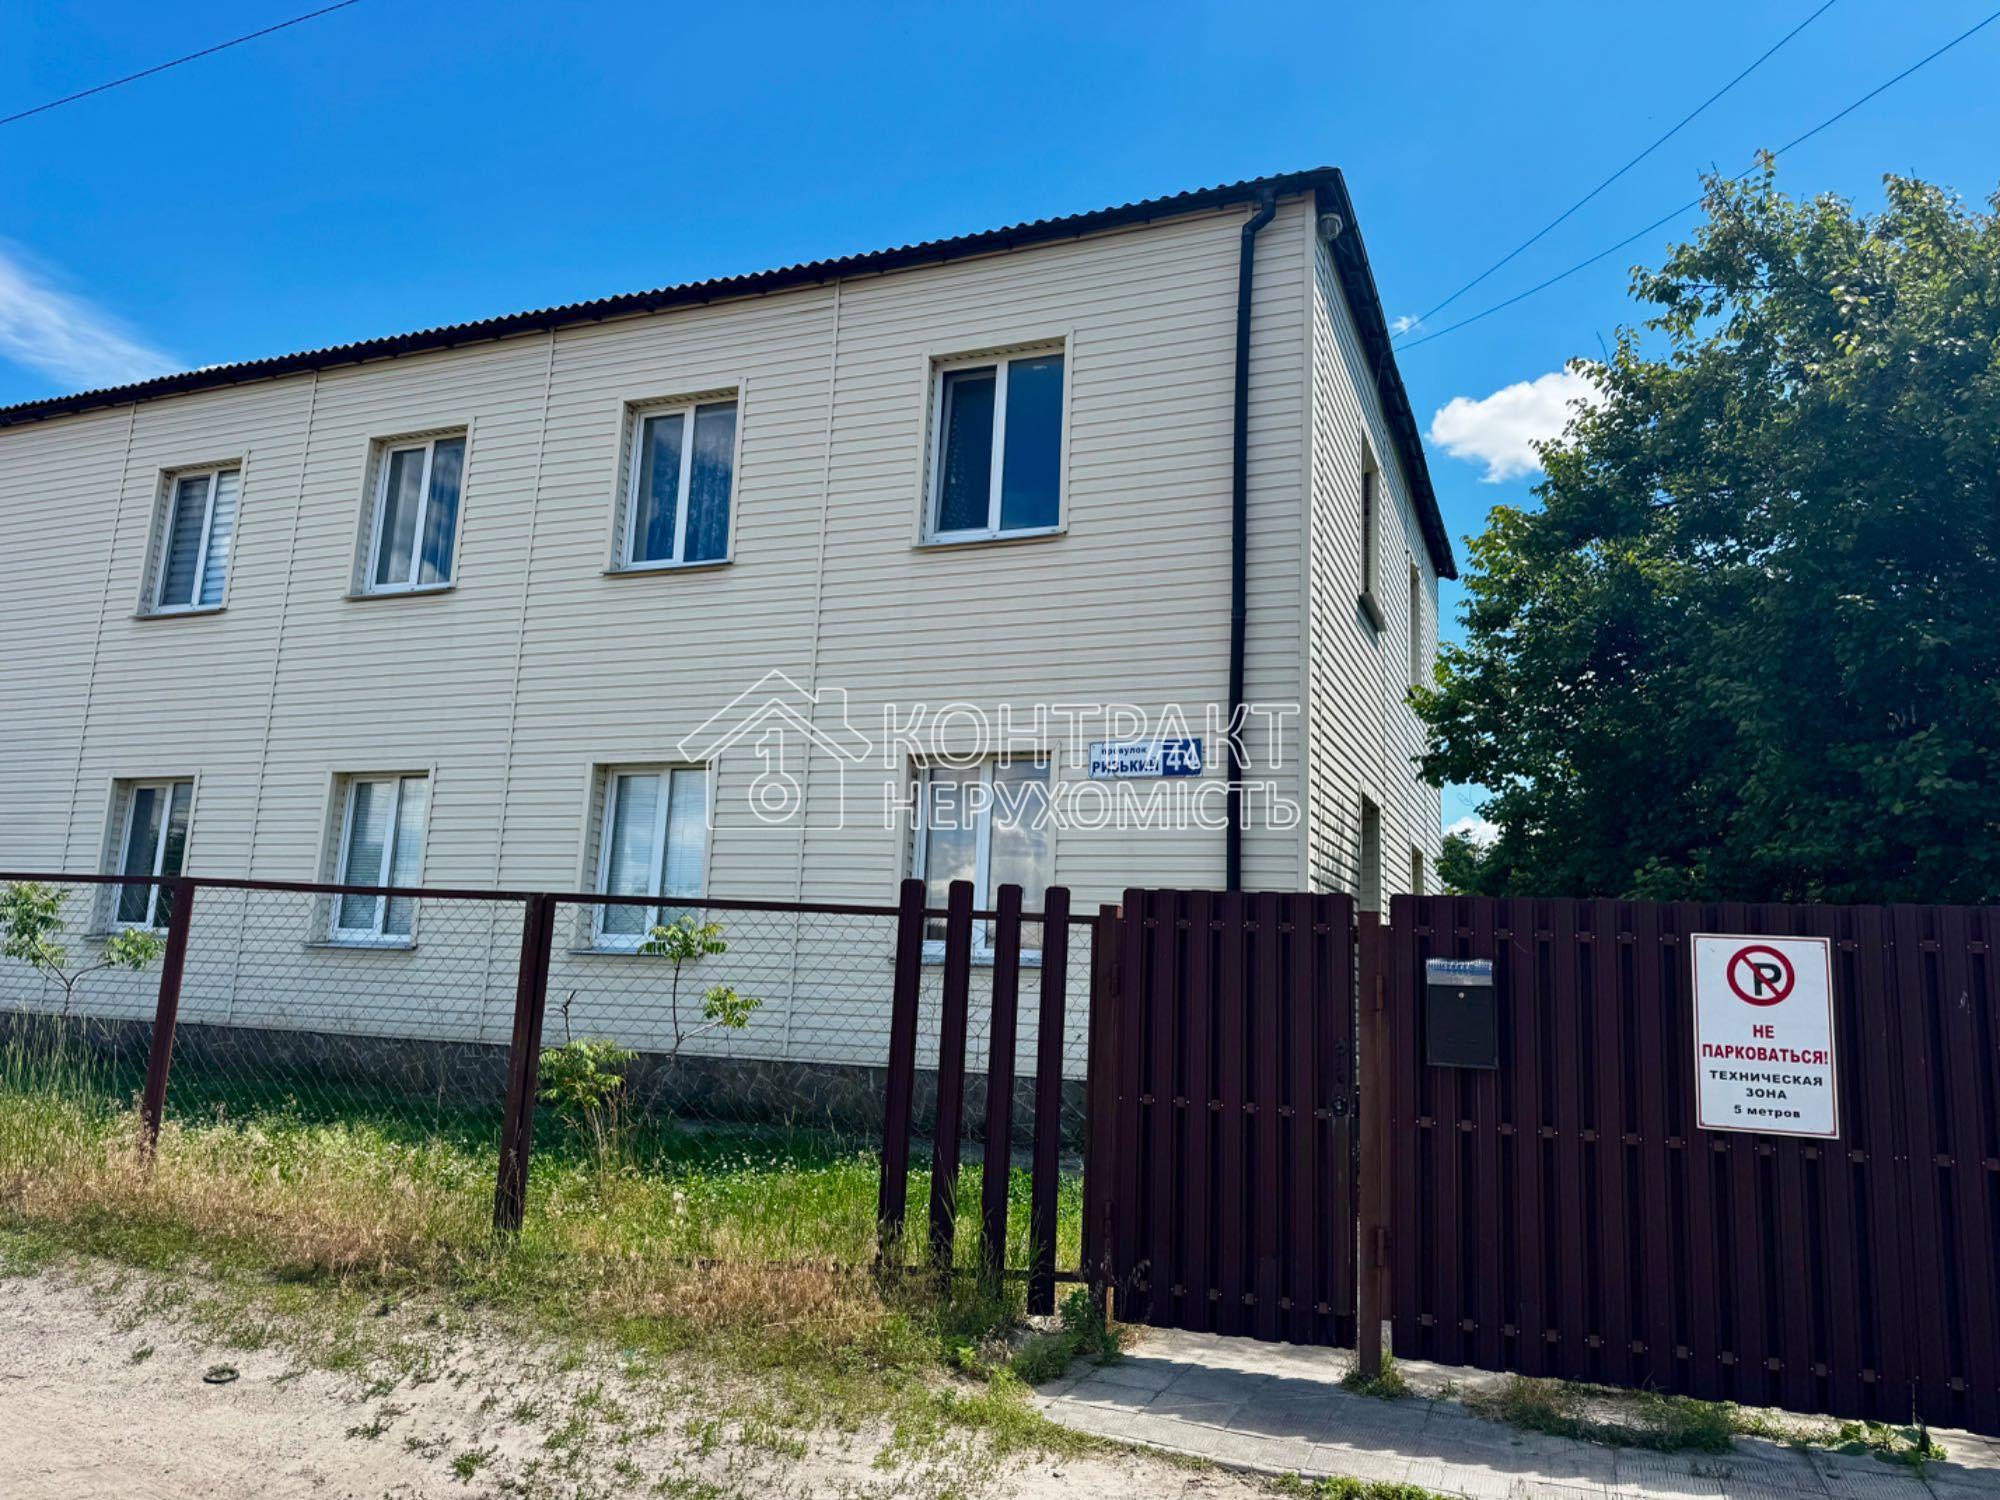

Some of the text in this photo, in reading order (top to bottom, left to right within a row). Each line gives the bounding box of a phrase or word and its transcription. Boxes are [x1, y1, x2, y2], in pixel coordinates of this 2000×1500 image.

[1092, 756, 1160, 773] РИЗЬКИЙ
[1752, 1024, 1775, 1039] НЕ
[1702, 1043, 1829, 1065] ПАРКОВАТЬСЯ!
[1709, 1070, 1823, 1087] ТЕХНИЧЕСКАЯ
[1746, 1087, 1787, 1100] ЗОНА
[1733, 1105, 1801, 1119] 5 метров
